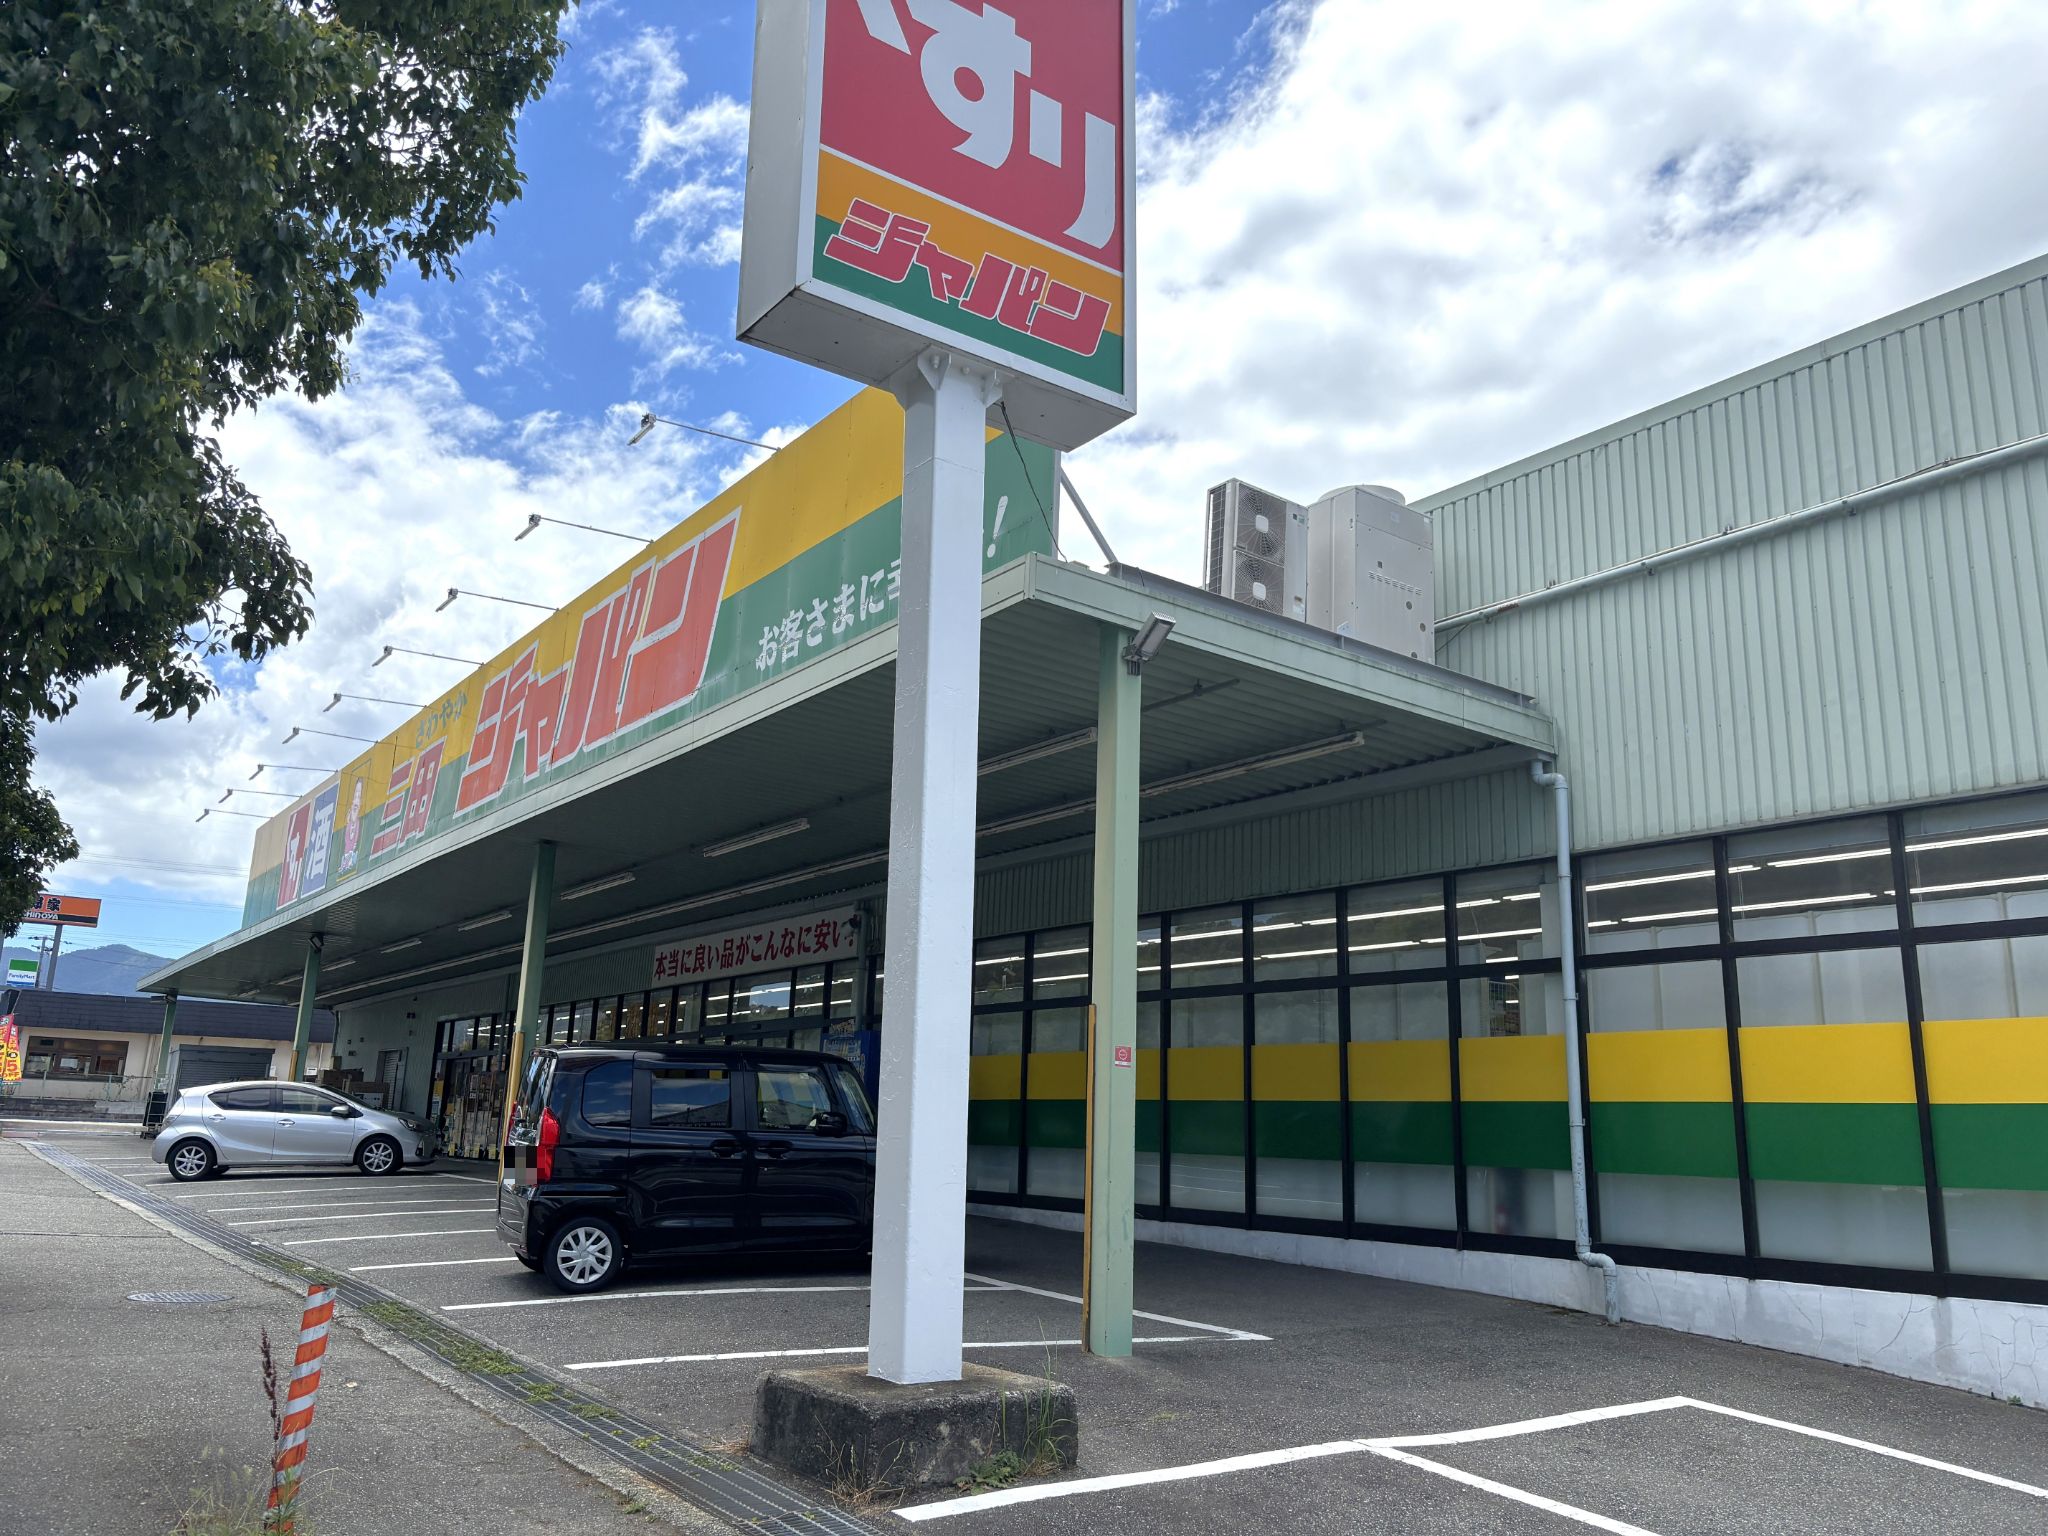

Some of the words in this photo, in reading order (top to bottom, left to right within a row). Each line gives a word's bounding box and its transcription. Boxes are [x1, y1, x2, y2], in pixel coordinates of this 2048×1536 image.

[823, 197, 1112, 357] ジャパン
[453, 506, 742, 818] ジャパン
[306, 802, 334, 880] 酒
[654, 917, 854, 980] 本当に良い品がこんなに安い
